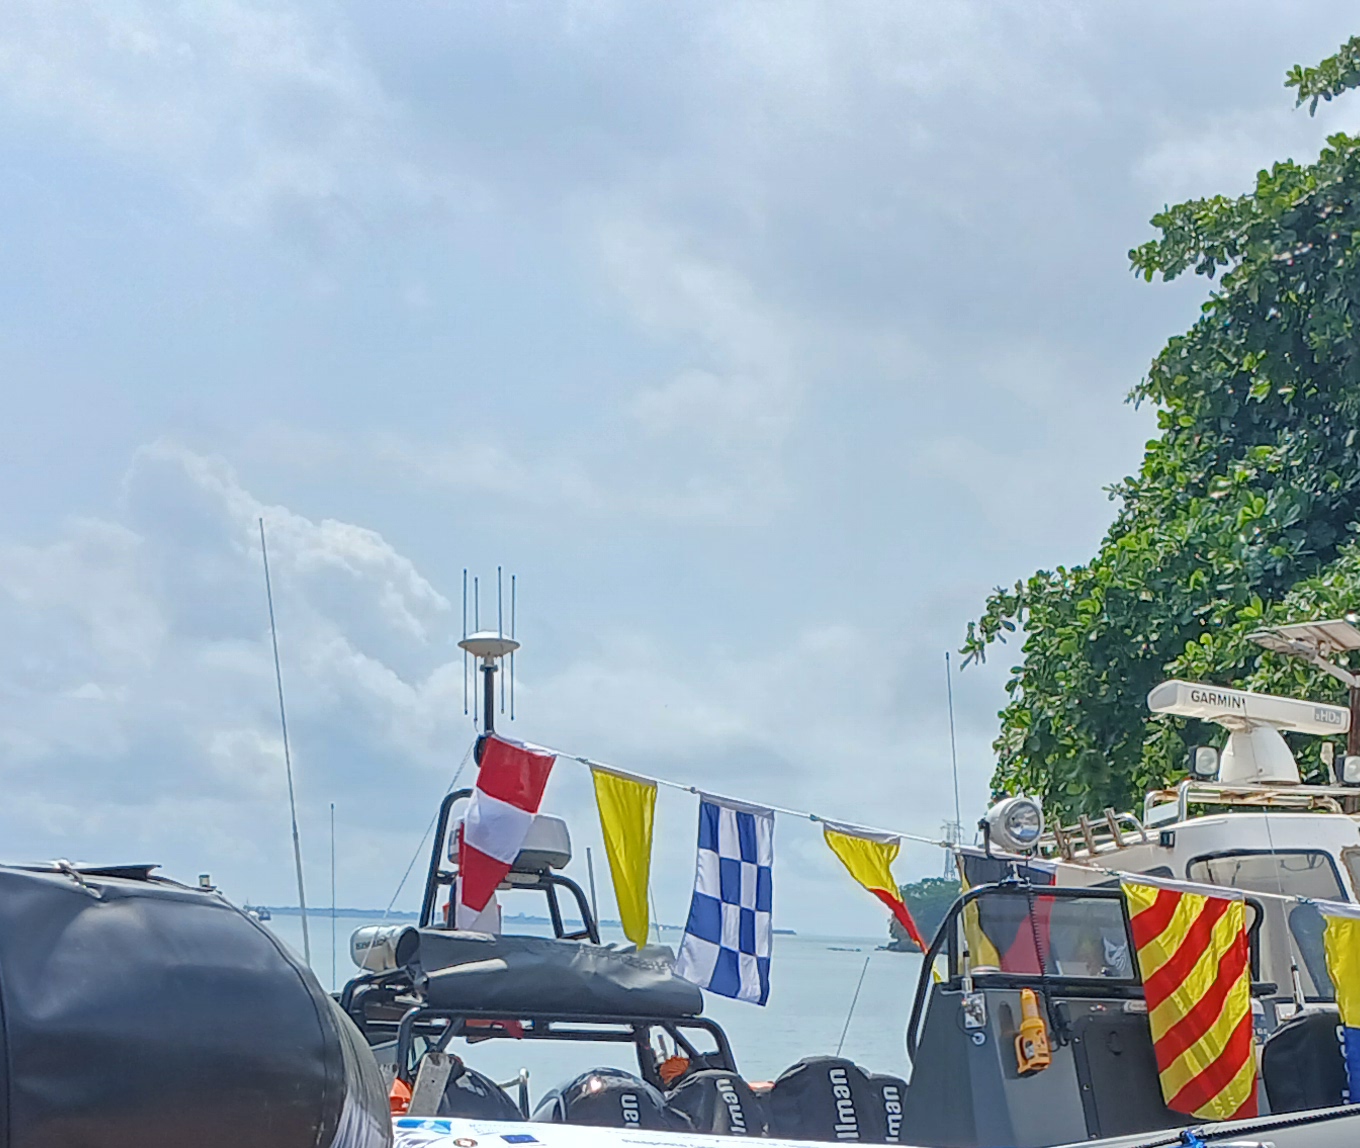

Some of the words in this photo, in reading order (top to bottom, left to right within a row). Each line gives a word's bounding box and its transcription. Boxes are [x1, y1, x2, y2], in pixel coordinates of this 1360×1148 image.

[1191, 689, 1241, 709] GARMIN
[715, 1078, 747, 1134] lman
[829, 1068, 860, 1141] llman
